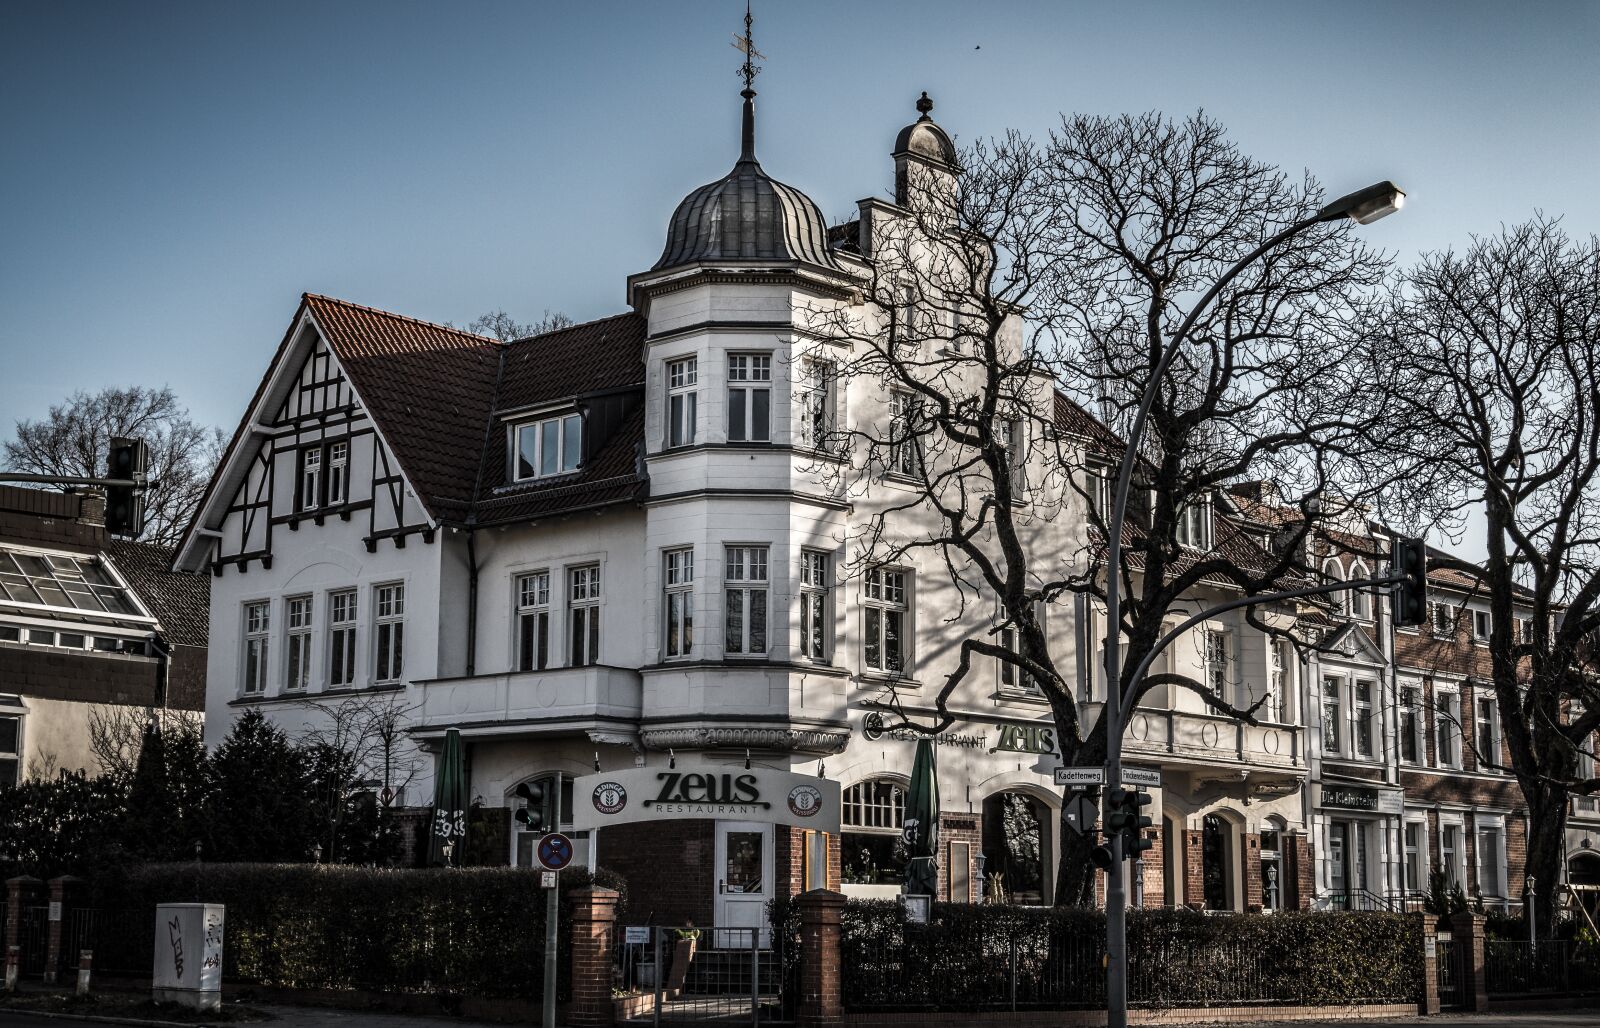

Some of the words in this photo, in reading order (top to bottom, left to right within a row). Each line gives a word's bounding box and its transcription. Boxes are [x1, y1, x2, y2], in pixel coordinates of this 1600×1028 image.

[1058, 771, 1101, 782] Kadettenweg
[1122, 769, 1159, 783] Finckensteinallee
[594, 783, 625, 796] ERDINGER
[1321, 790, 1334, 804] Die
[656, 804, 758, 814] RESTAURANT
